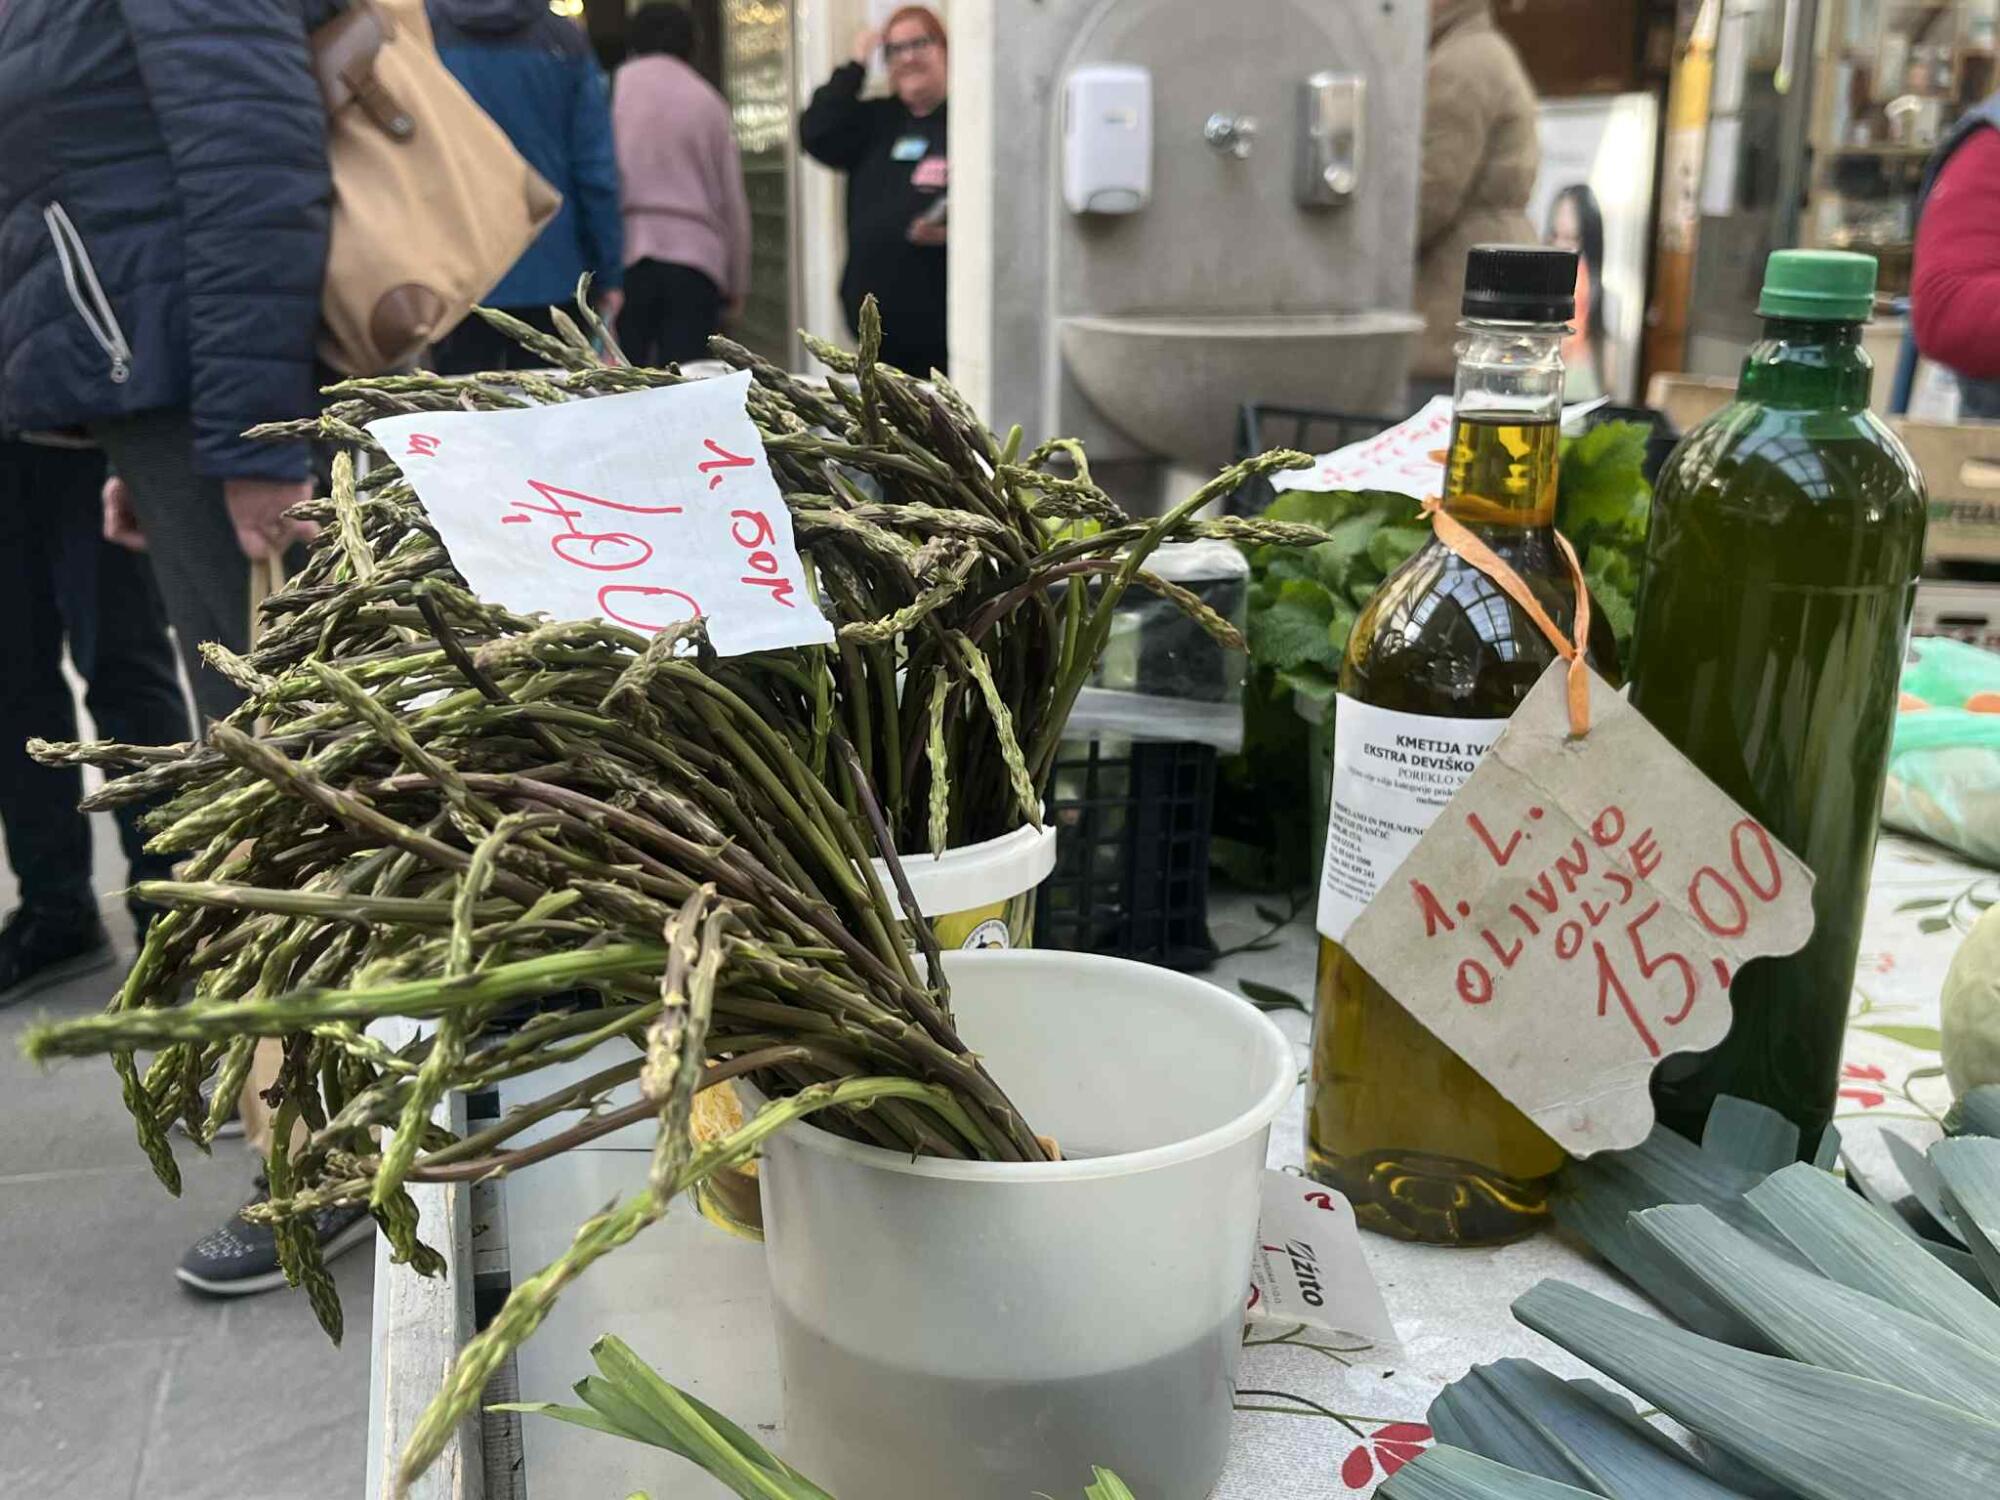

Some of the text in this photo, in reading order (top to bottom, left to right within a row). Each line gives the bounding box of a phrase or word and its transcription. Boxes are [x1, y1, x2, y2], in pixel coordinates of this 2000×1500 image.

[699, 438, 755, 490] 1.
[1364, 743, 1475, 772] EKSTRA DEVIŠKO
[1396, 735, 1459, 755] KMETIJA
[1398, 767, 1454, 785] POREKLO
[1409, 878, 1470, 936] 1.
[1456, 805, 1625, 1005] OLIVNO
[1555, 827, 1663, 960] OLJE
[1593, 818, 1783, 1057] 15,00
